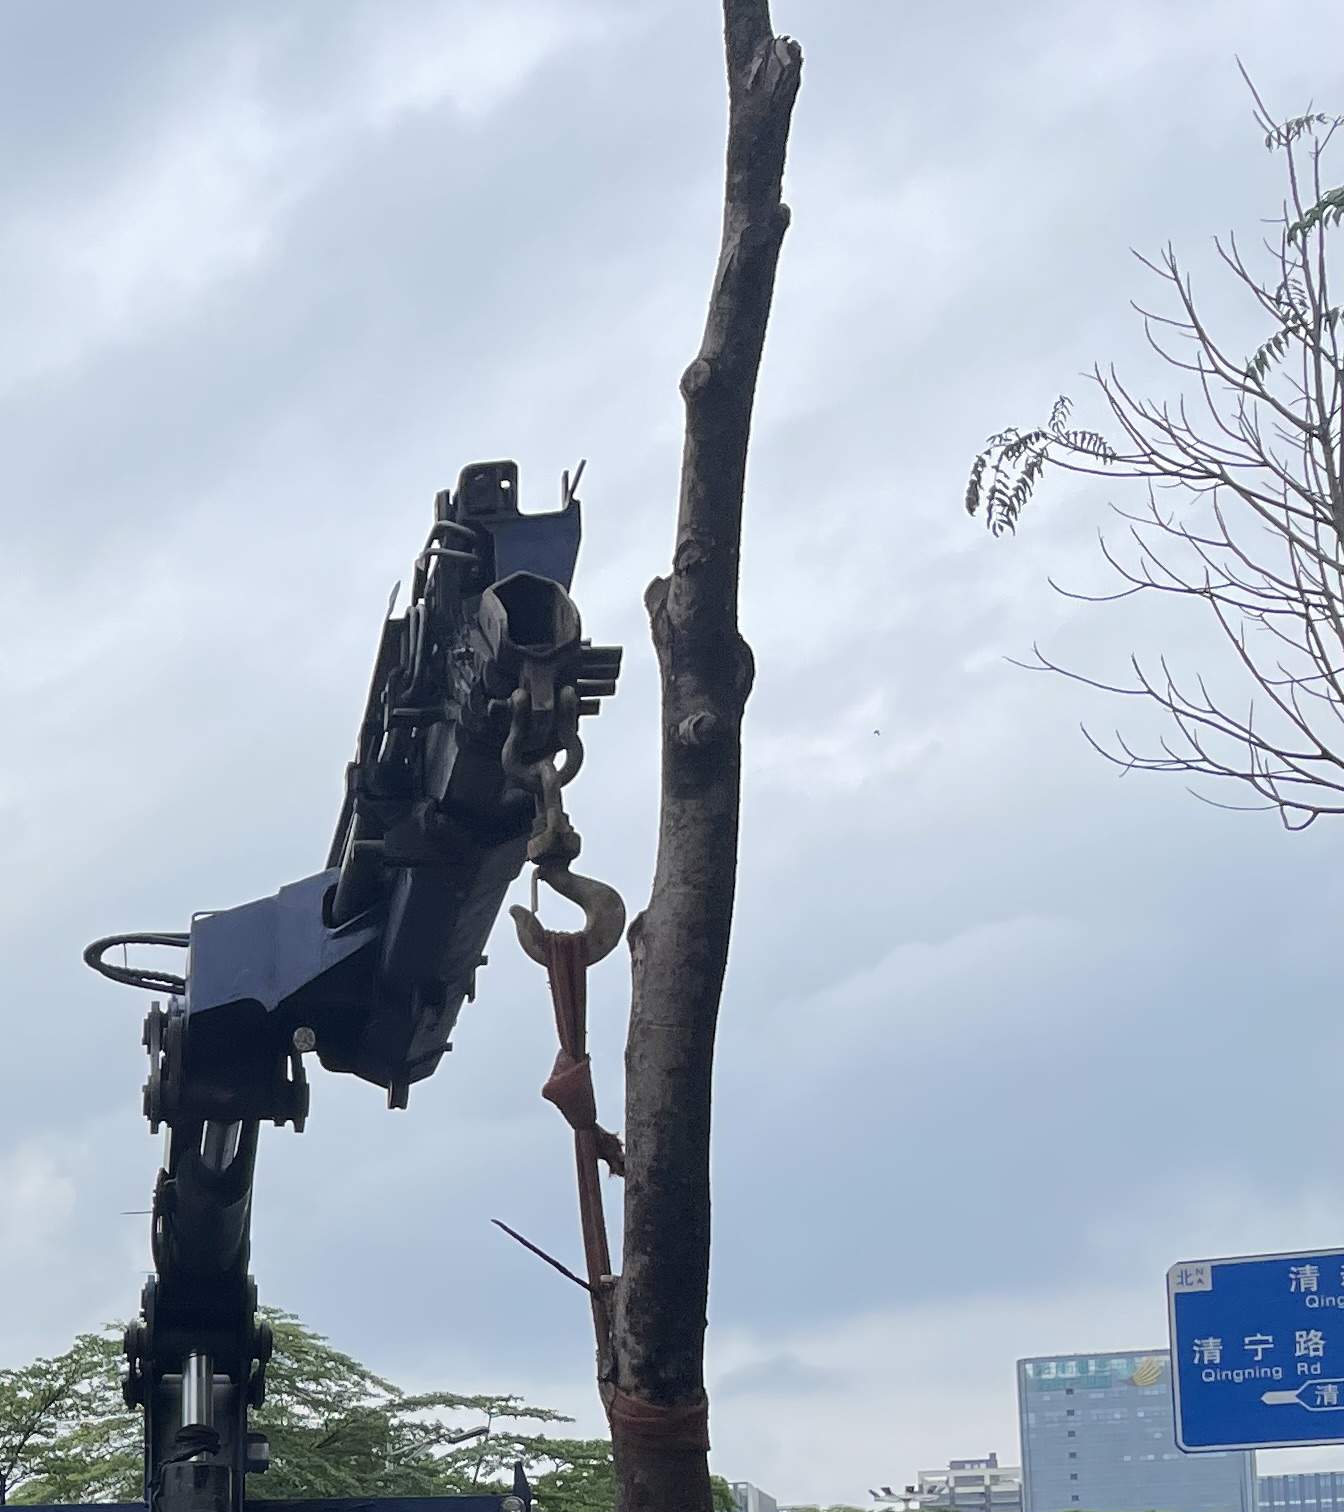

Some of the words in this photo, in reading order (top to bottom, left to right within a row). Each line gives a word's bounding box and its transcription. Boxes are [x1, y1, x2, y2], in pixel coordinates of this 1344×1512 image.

[1176, 1269, 1194, 1286] 北
[1288, 1264, 1344, 1293] 清
[1192, 1329, 1327, 1365] 清宁路
[1201, 1365, 1283, 1383] Qingning
[1296, 1362, 1322, 1376] Rd
